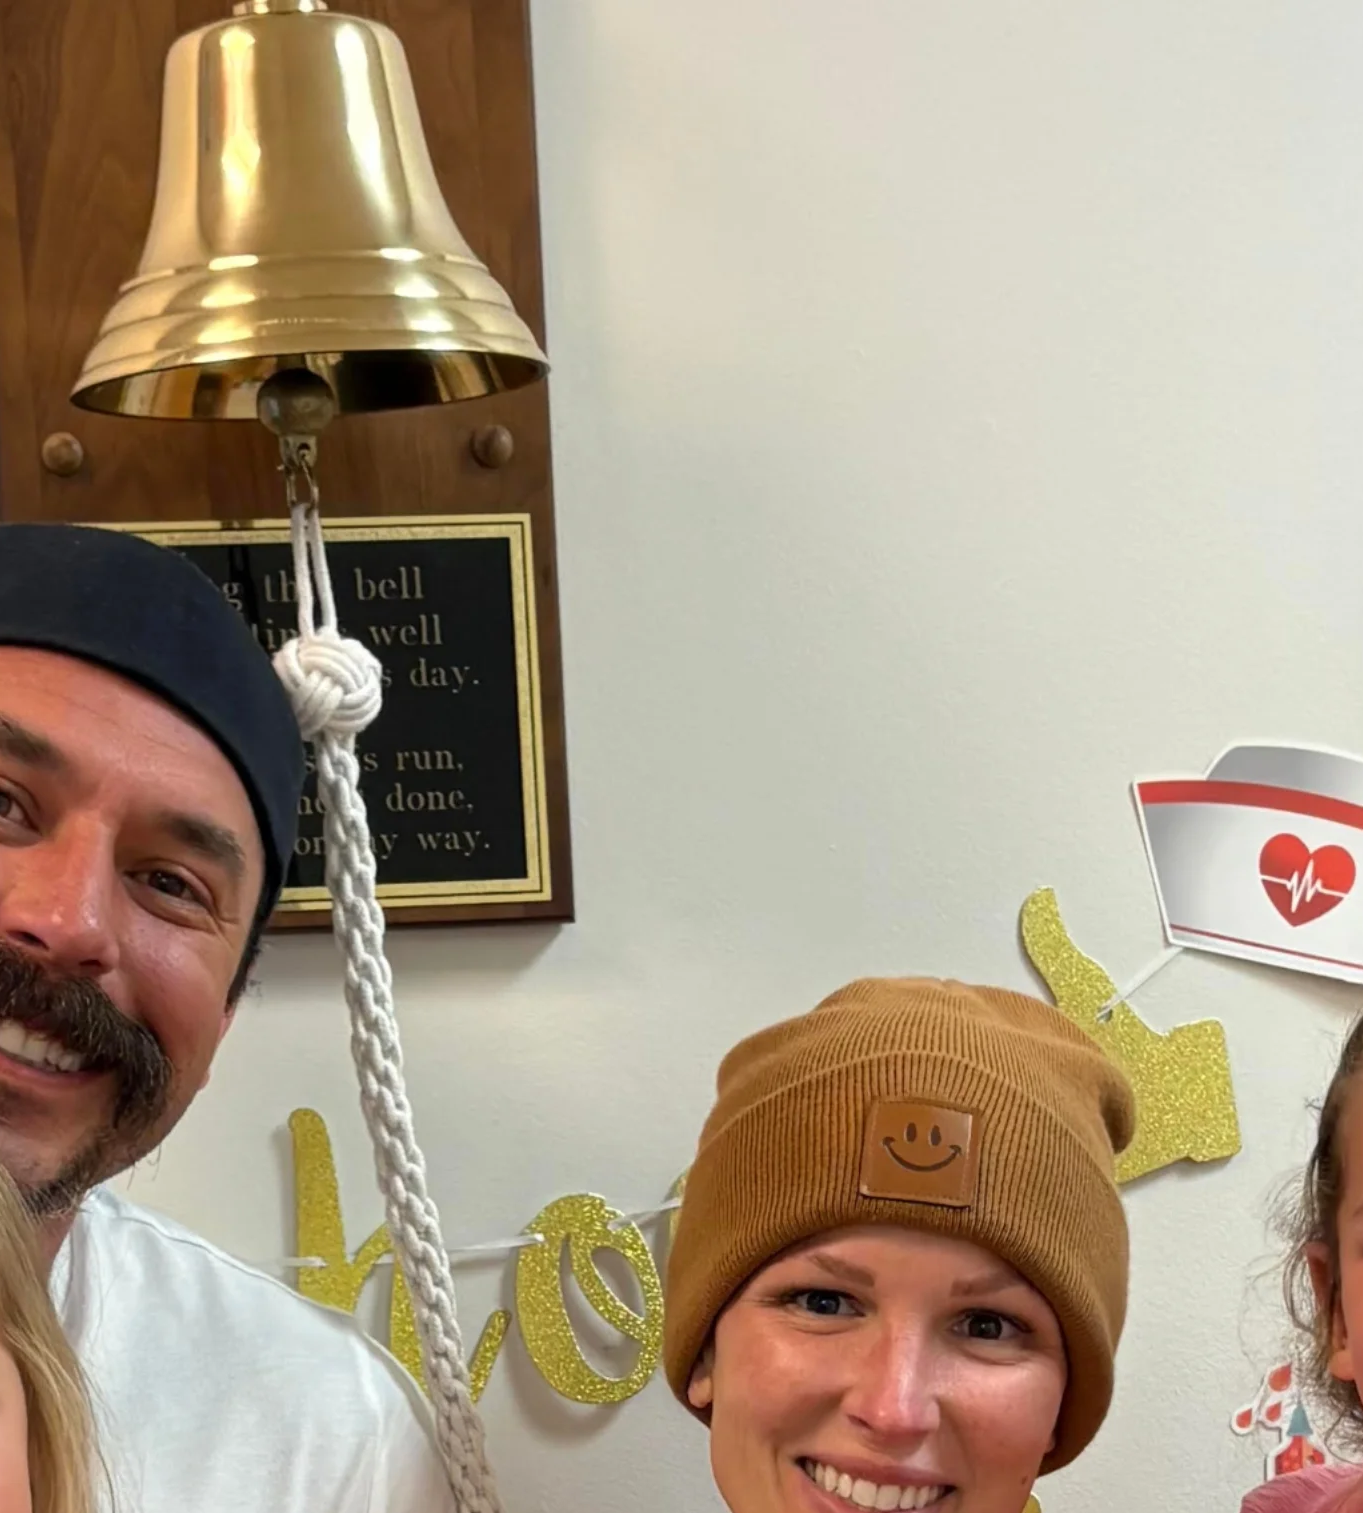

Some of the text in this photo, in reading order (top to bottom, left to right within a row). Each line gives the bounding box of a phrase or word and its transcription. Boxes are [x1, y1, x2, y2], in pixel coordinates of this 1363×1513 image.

[354, 566, 426, 600] bell
[368, 614, 444, 645] well
[409, 658, 480, 694] day.
[396, 749, 464, 772] run,
[385, 782, 474, 814] done,
[417, 829, 490, 858] way.
